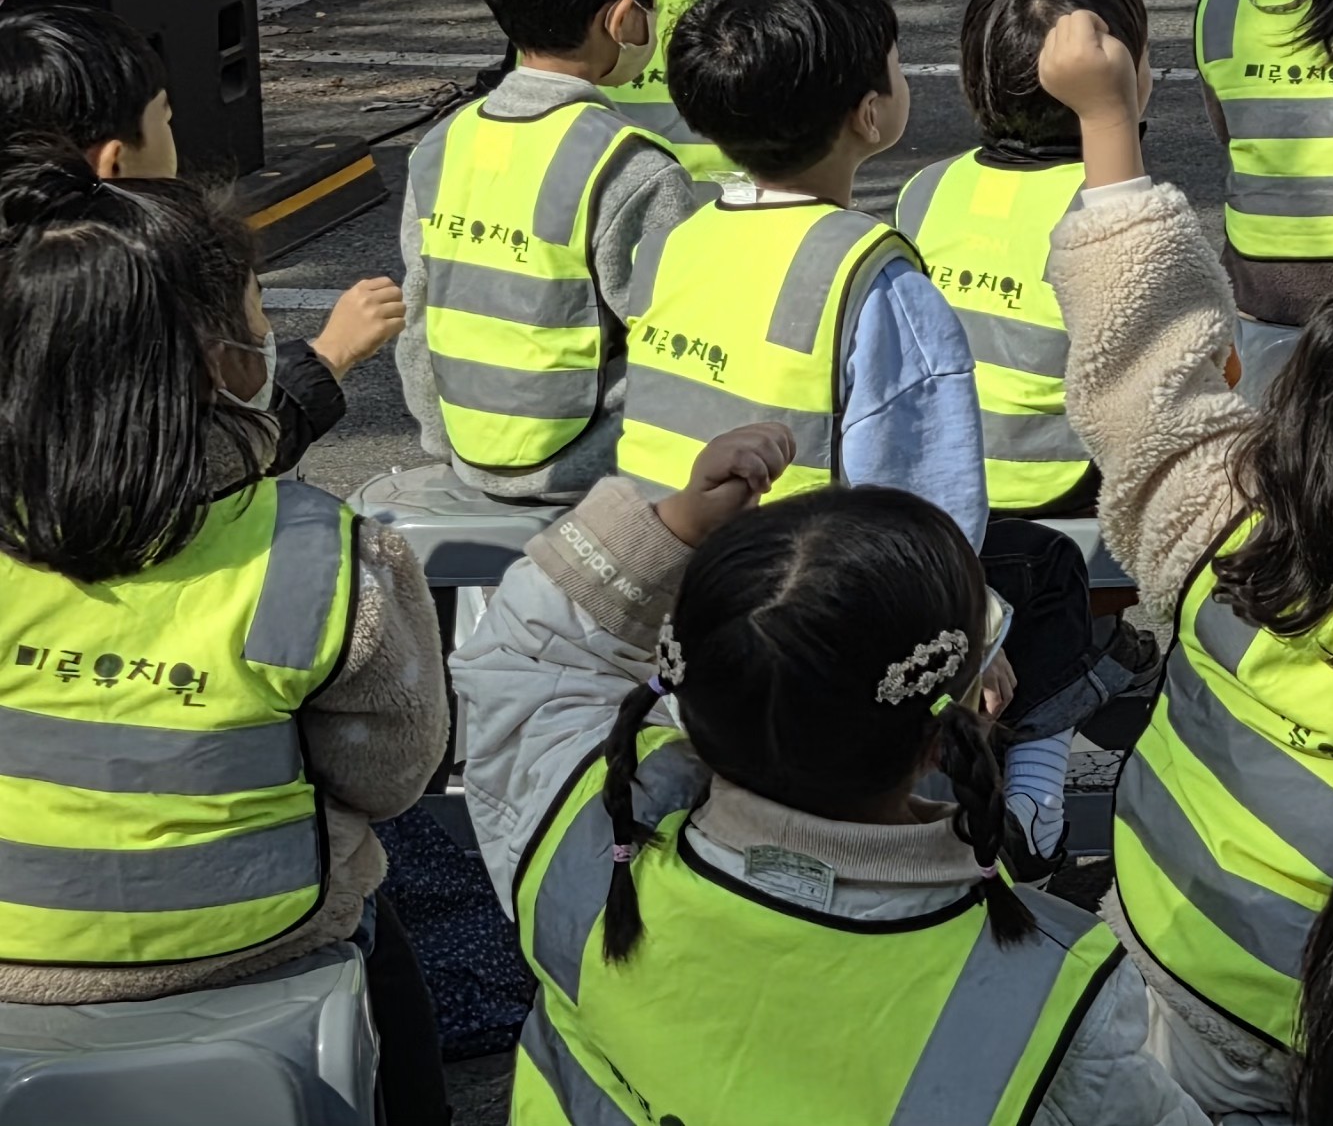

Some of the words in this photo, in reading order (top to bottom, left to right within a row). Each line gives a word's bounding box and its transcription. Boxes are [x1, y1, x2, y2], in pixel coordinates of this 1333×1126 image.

[642, 325, 728, 384] 미루유치원
[560, 522, 618, 585] balance
[16, 644, 208, 708] 미루유치원
